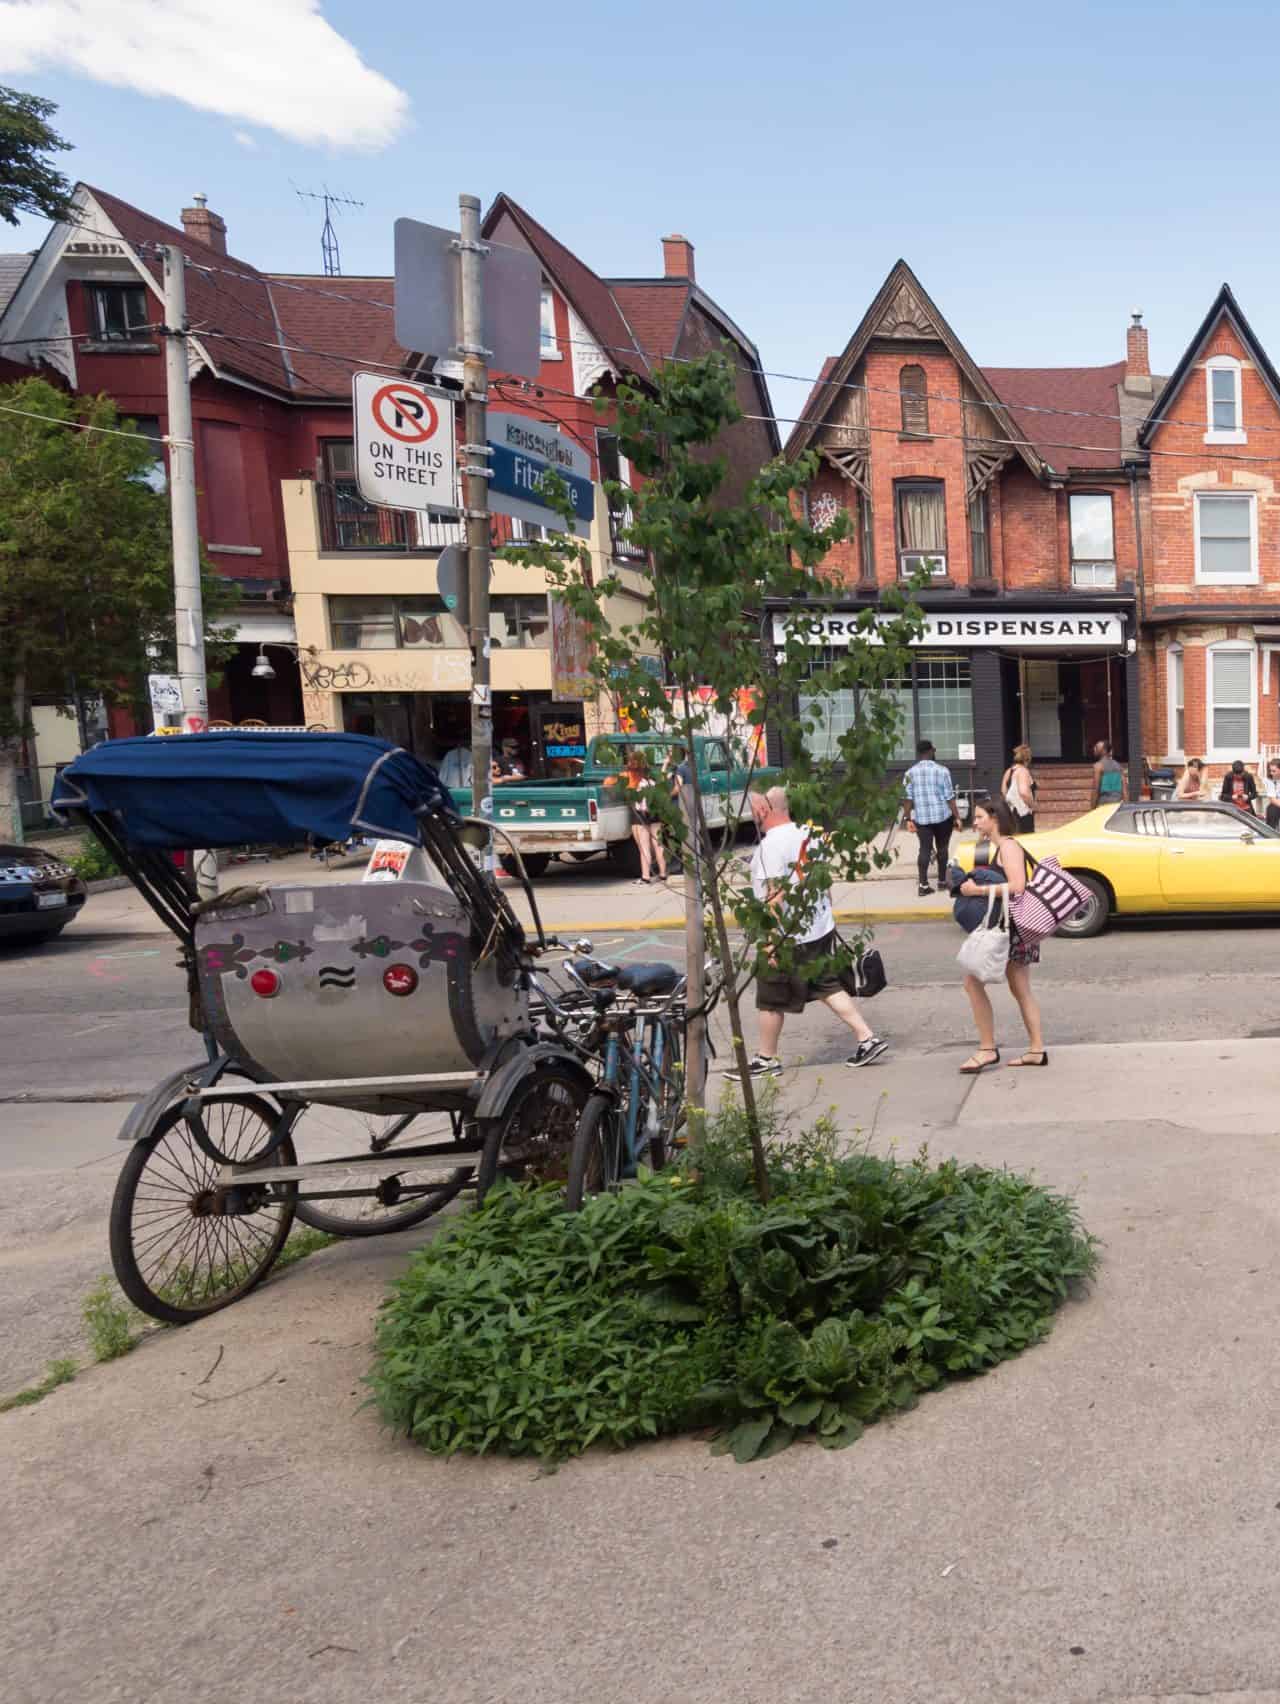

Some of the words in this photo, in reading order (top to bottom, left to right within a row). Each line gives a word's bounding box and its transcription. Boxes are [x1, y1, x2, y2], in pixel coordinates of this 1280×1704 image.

[369, 441, 393, 459] ON
[405, 447, 443, 468] THIS
[374, 462, 437, 486] STREET
[937, 620, 1112, 636] DISPENSARY
[499, 808, 577, 817] ORD
